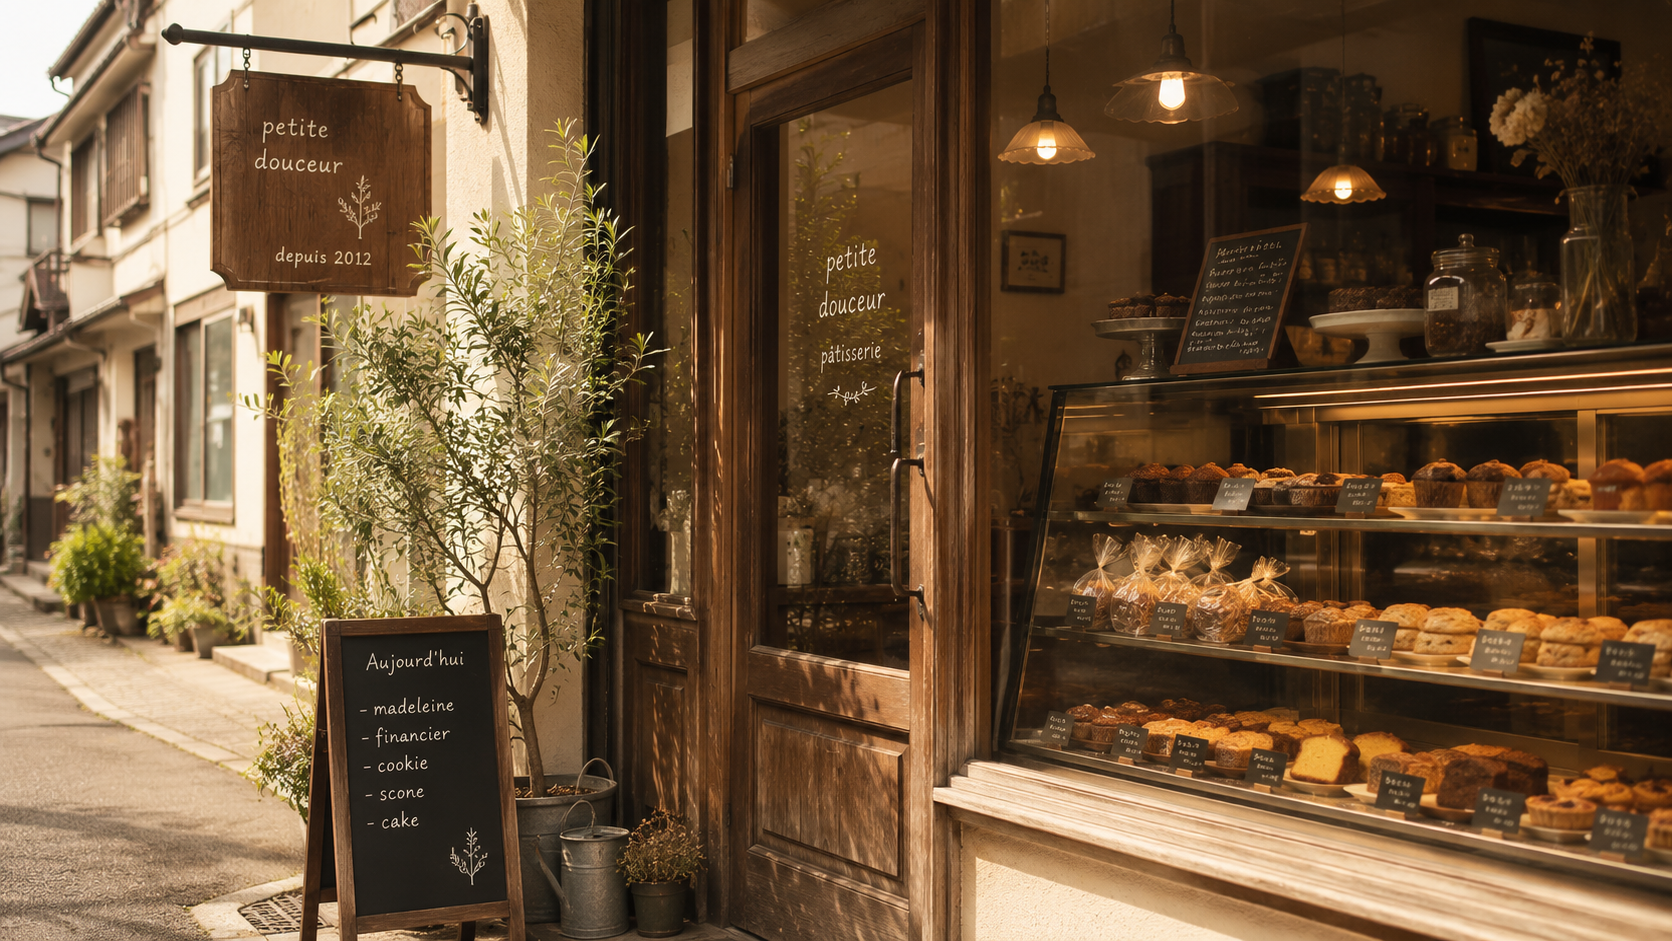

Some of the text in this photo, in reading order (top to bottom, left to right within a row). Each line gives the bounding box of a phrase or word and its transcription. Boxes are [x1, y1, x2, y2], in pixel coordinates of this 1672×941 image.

[262, 118, 329, 144] petite
[254, 148, 344, 174] douceur
[275, 246, 373, 268] depuis 2012
[826, 242, 877, 284] petite
[819, 290, 886, 318] douceur
[365, 649, 465, 676] Aujourd'hui
[373, 696, 455, 716] madeleine
[375, 726, 451, 748] financier
[377, 754, 429, 773] cookie
[379, 787, 425, 802] scone
[381, 810, 420, 830] cake
